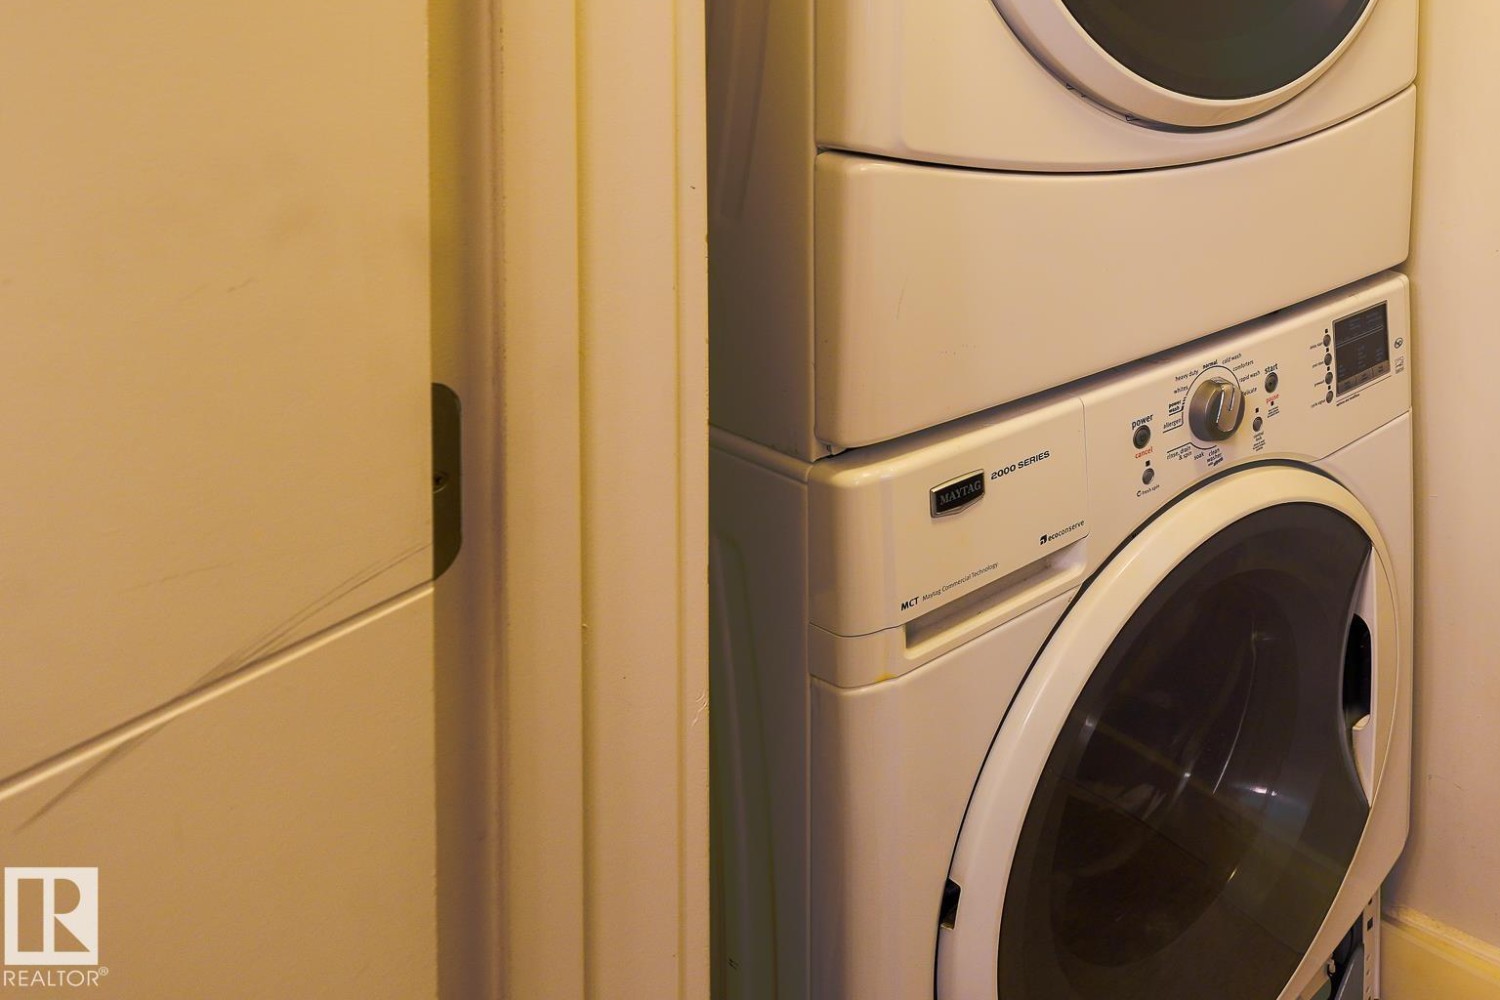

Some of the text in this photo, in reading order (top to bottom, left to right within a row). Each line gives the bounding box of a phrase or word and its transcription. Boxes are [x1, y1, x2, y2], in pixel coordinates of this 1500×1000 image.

[1202, 359, 1218, 369] normal
[1264, 363, 1279, 375] start
[1174, 369, 1199, 383] heavy duty
[1239, 370, 1261, 383] rapid wash
[1168, 399, 1182, 409] power
[1131, 414, 1154, 430] power
[1135, 446, 1153, 459] cancel
[990, 450, 1051, 481] 2000 SERIES
[939, 480, 982, 506] MAYTAG
[900, 562, 999, 611] MCT Maytag Commercial Technology
